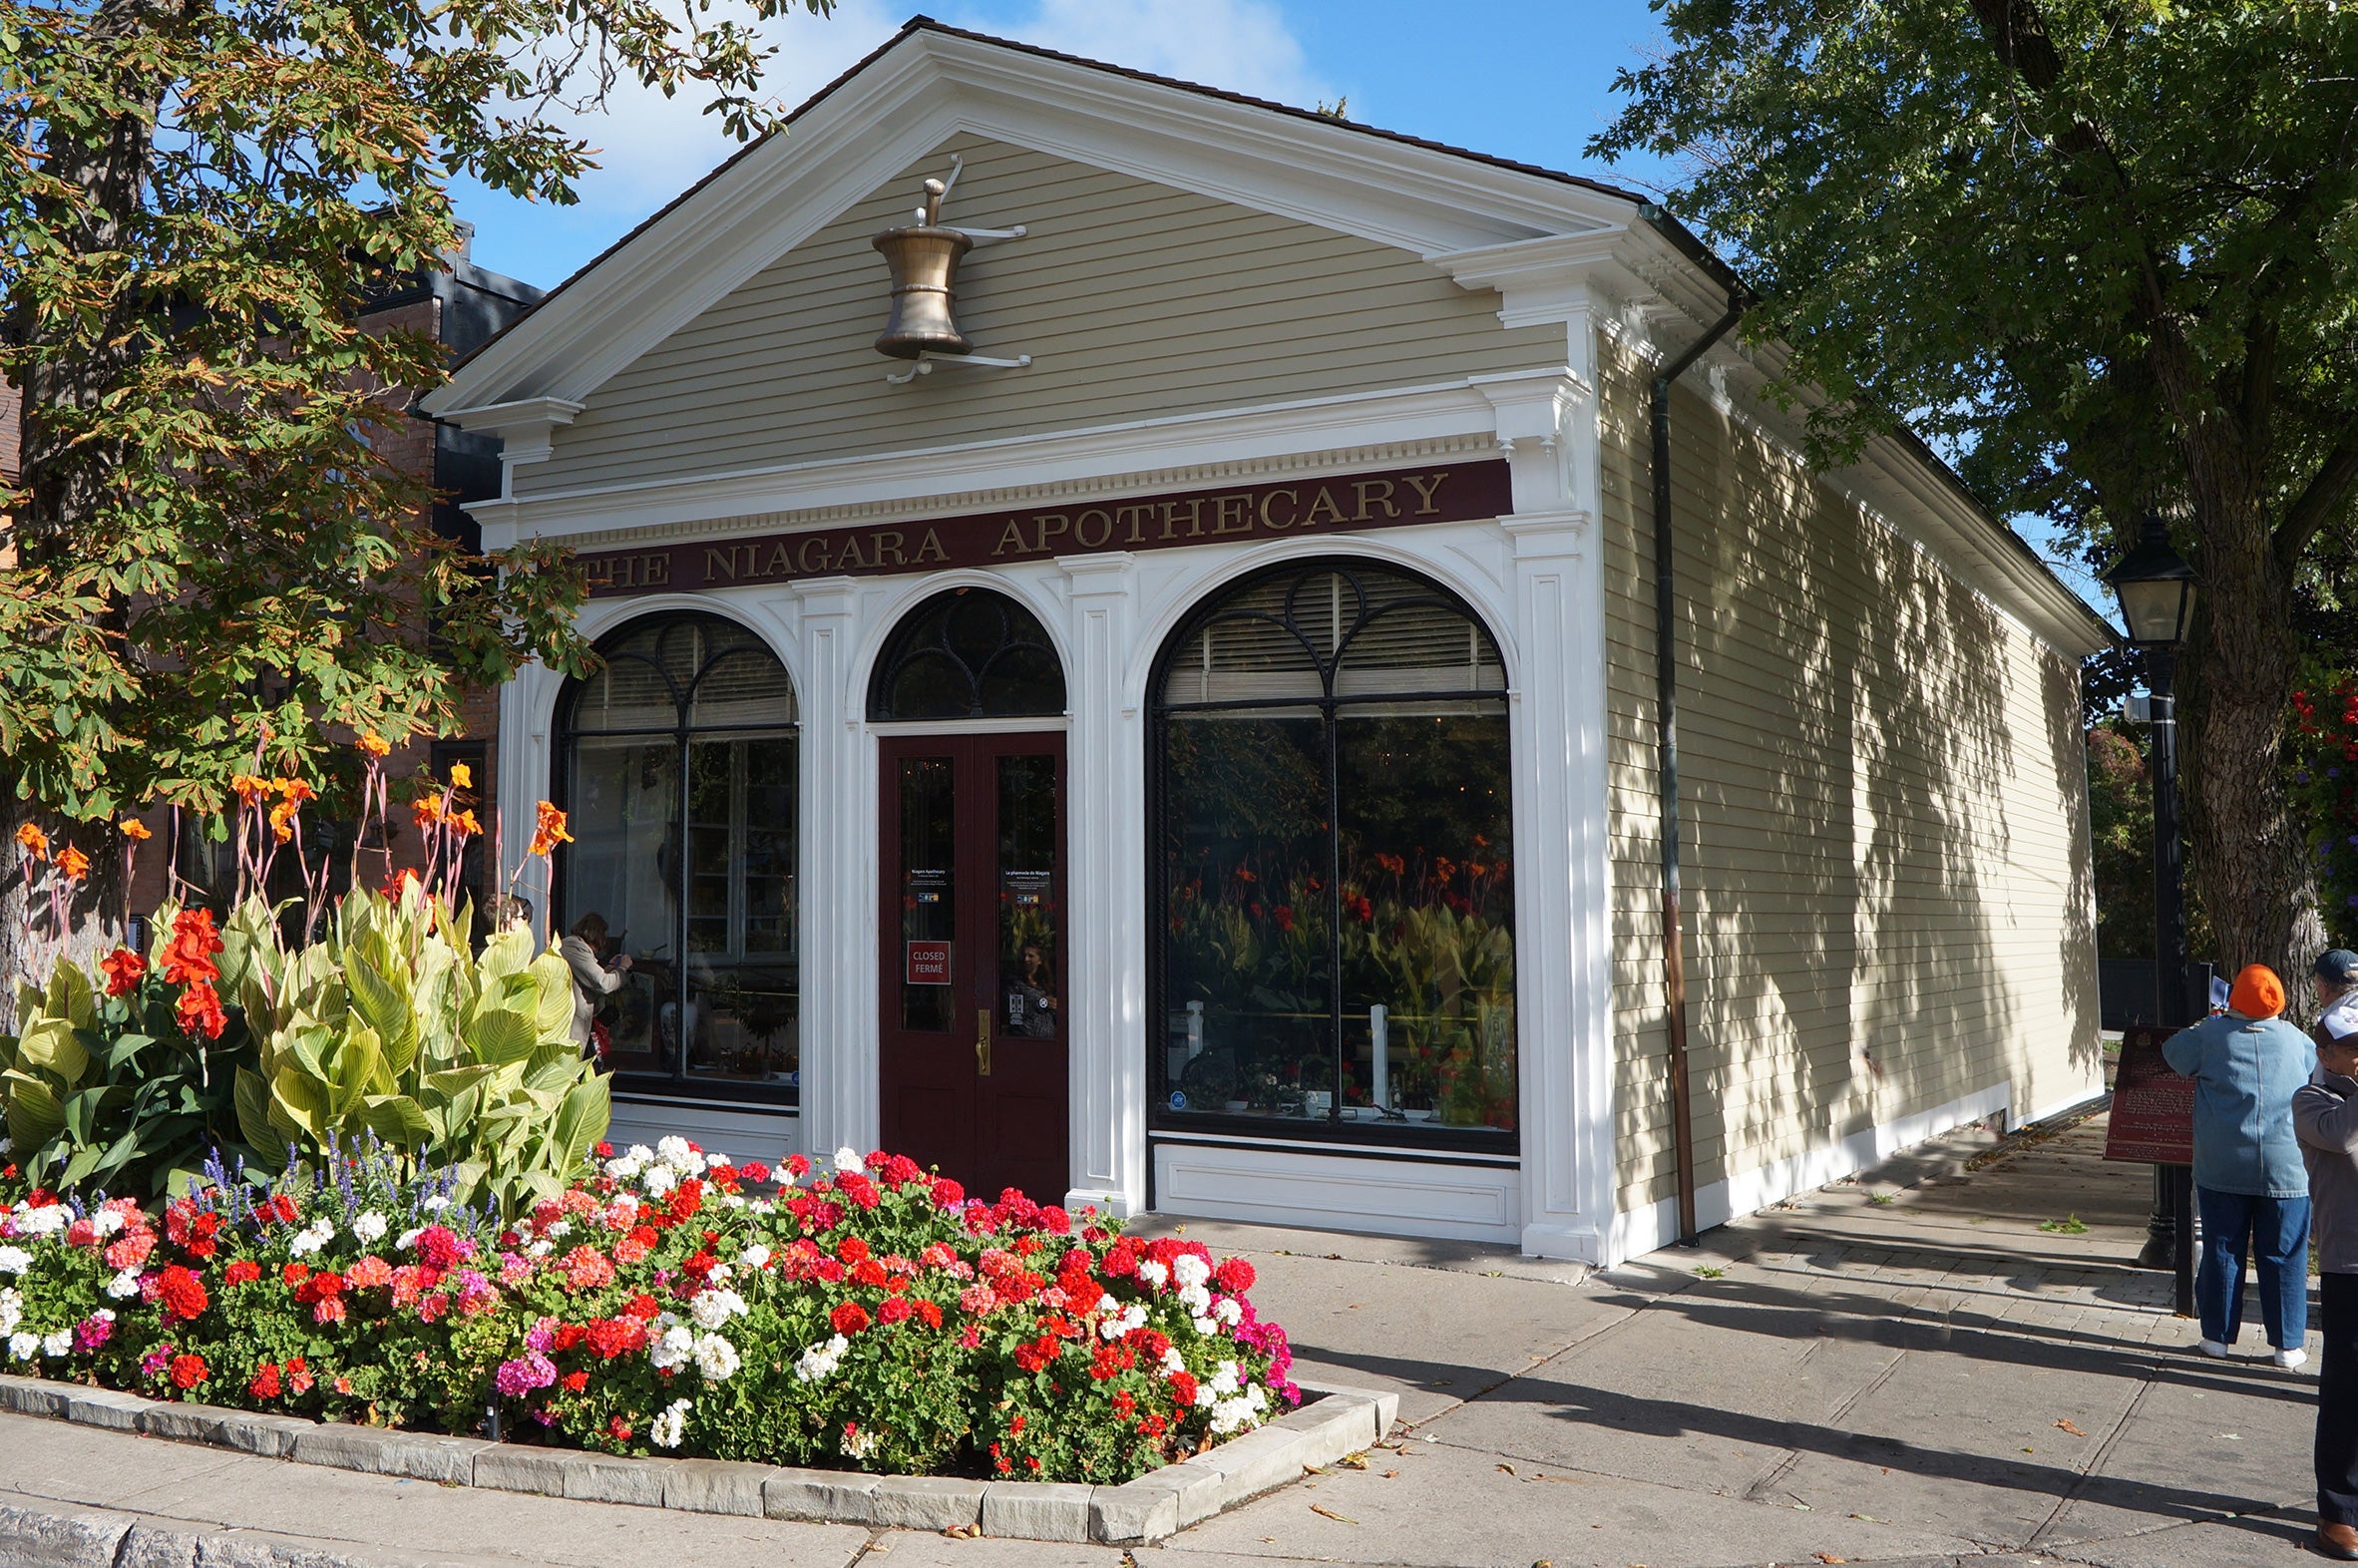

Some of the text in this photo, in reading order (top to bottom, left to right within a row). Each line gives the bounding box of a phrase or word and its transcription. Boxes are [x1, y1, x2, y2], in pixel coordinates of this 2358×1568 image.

[703, 527, 950, 582] NIAGARA
[990, 473, 1449, 557] APOTHECARY
[913, 951, 946, 961] CLOSED
[916, 963, 944, 974] FERMÉ
